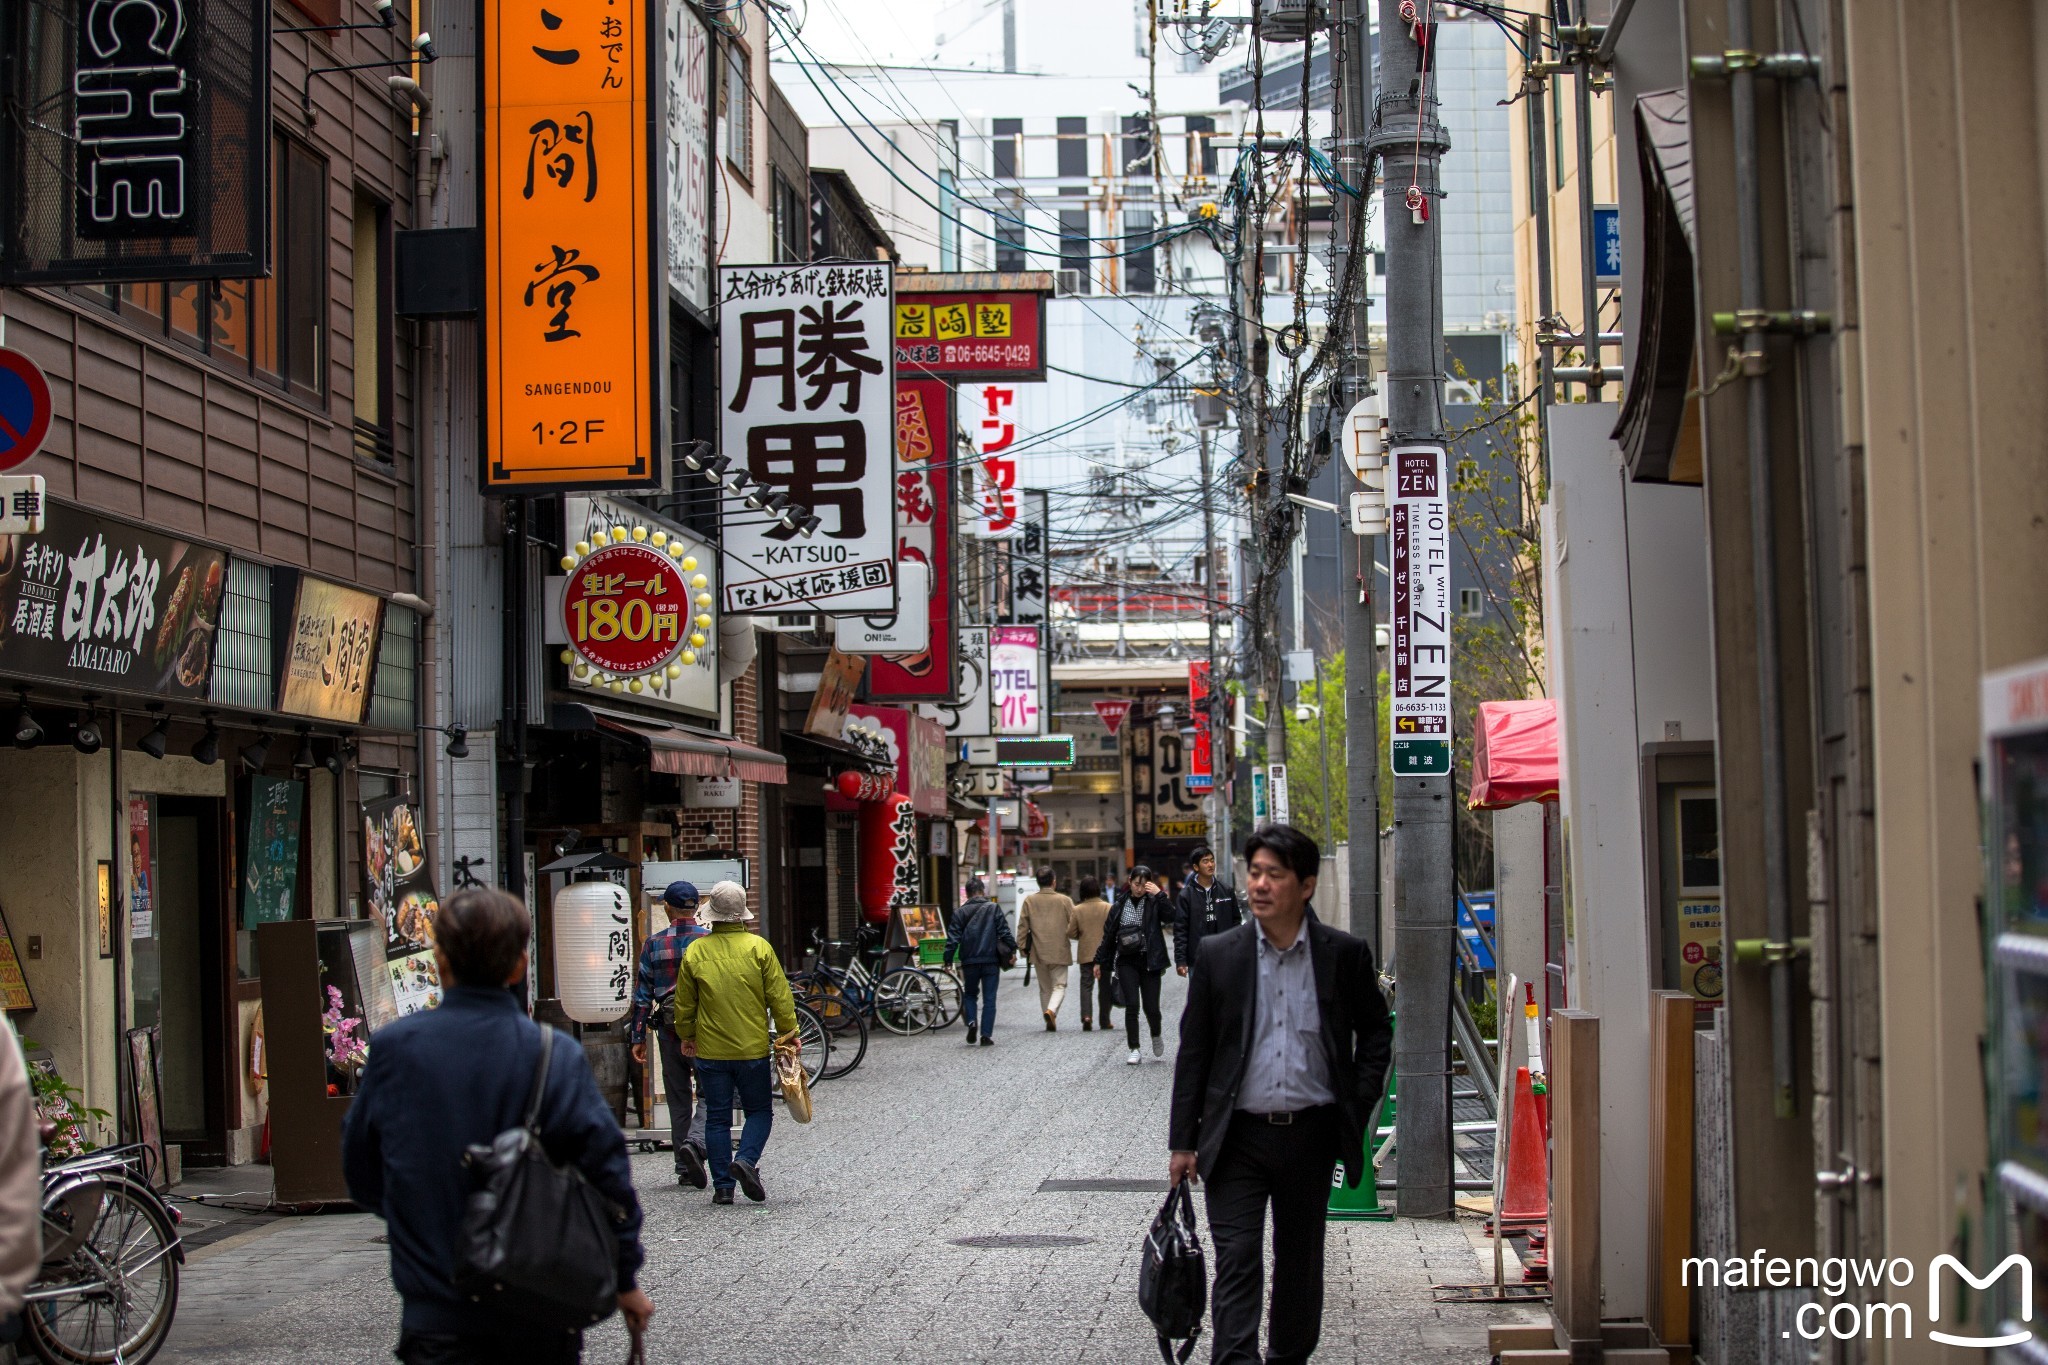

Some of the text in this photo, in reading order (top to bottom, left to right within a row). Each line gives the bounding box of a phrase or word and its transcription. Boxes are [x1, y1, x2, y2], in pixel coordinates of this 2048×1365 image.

[726, 266, 888, 300] 大分からあげと鉄板焼
[957, 345, 1031, 364] 06-6645-0429
[524, 382, 612, 396] SANGENDOU
[727, 300, 884, 542] 勝男
[1405, 459, 1430, 468] HOTEL
[1400, 475, 1436, 491] ZEN
[0, 489, 41, 521] 車
[22, 541, 64, 586] 手作り
[1411, 503, 1421, 608] TIMELESS RESORT
[62, 532, 161, 656] 甘太郎
[582, 572, 668, 597] 生ビール
[735, 562, 888, 607] なんば応援団
[1395, 510, 1408, 693] ホテル ゼン 千日前 店
[1413, 503, 1446, 698] HOTEL WITH ZEN
[11, 599, 57, 641] 居酒屋
[571, 598, 679, 643] 180円
[864, 633, 882, 643] ON!
[67, 642, 132, 675] AMATARO
[1395, 703, 1446, 712] 06-6635-1133
[1684, 904, 1721, 915] 自転車の
[608, 890, 633, 1002] 三間堂
